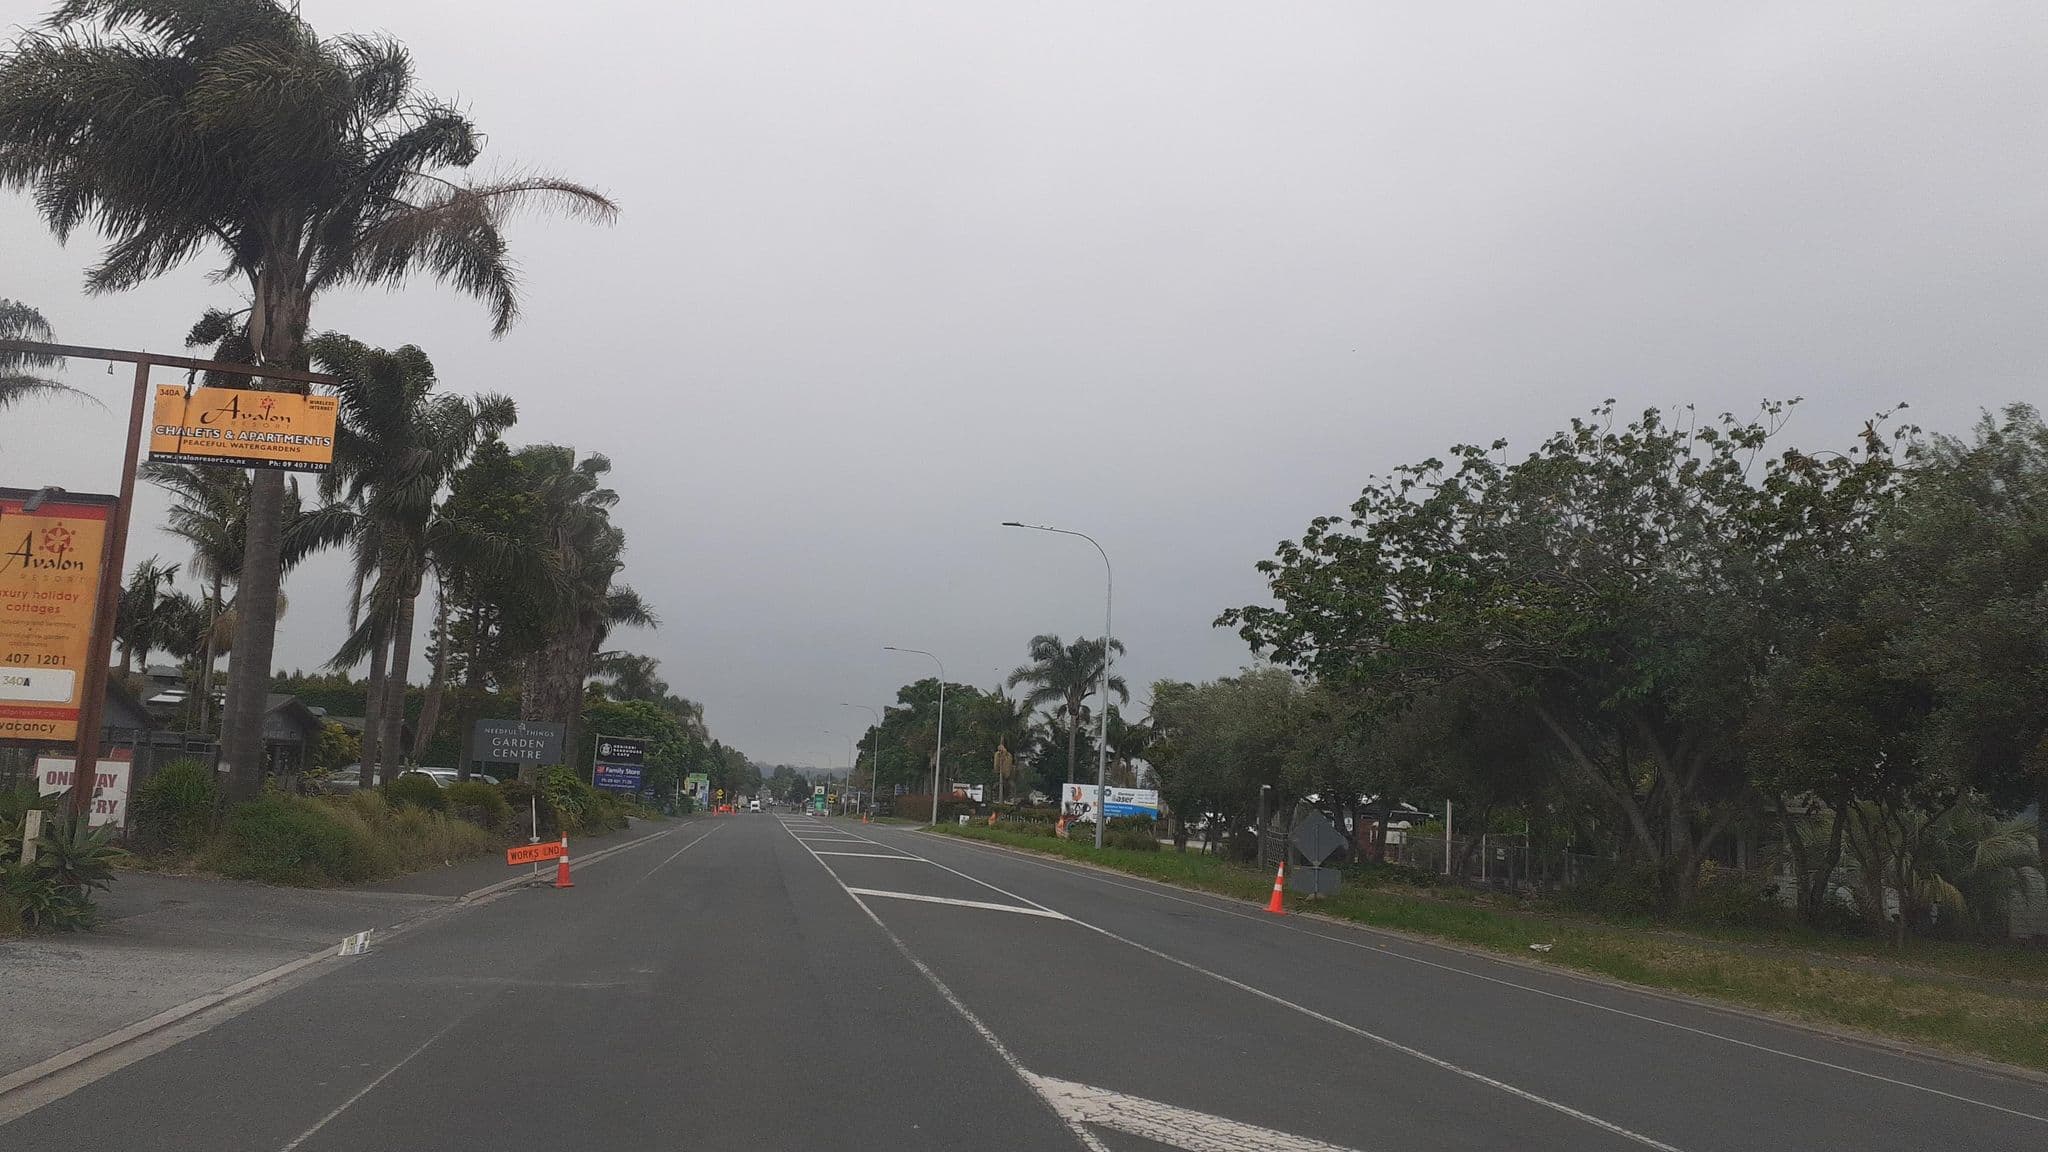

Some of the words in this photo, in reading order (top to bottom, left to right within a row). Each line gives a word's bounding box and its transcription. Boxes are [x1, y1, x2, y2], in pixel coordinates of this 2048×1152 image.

[159, 388, 181, 397] 340A
[200, 394, 291, 425] Avalon
[155, 425, 220, 438] CHALETS
[225, 430, 235, 440] &
[238, 431, 331, 447] APARTMENTS
[183, 439, 227, 448] PEACEFUL
[230, 442, 301, 453] WATERGARDENS
[0, 530, 84, 573] Avalon
[32, 589, 80, 602] holiday
[6, 603, 61, 615] cottages
[5, 653, 30, 664] 407
[37, 654, 66, 666] 1201
[3, 675, 30, 687] 340A
[484, 727, 517, 736] NEEDFUL
[526, 729, 555, 738] THINGS
[492, 737, 545, 749] GARDEN
[493, 748, 542, 760] CENTRE
[510, 848, 540, 861] WORKS
